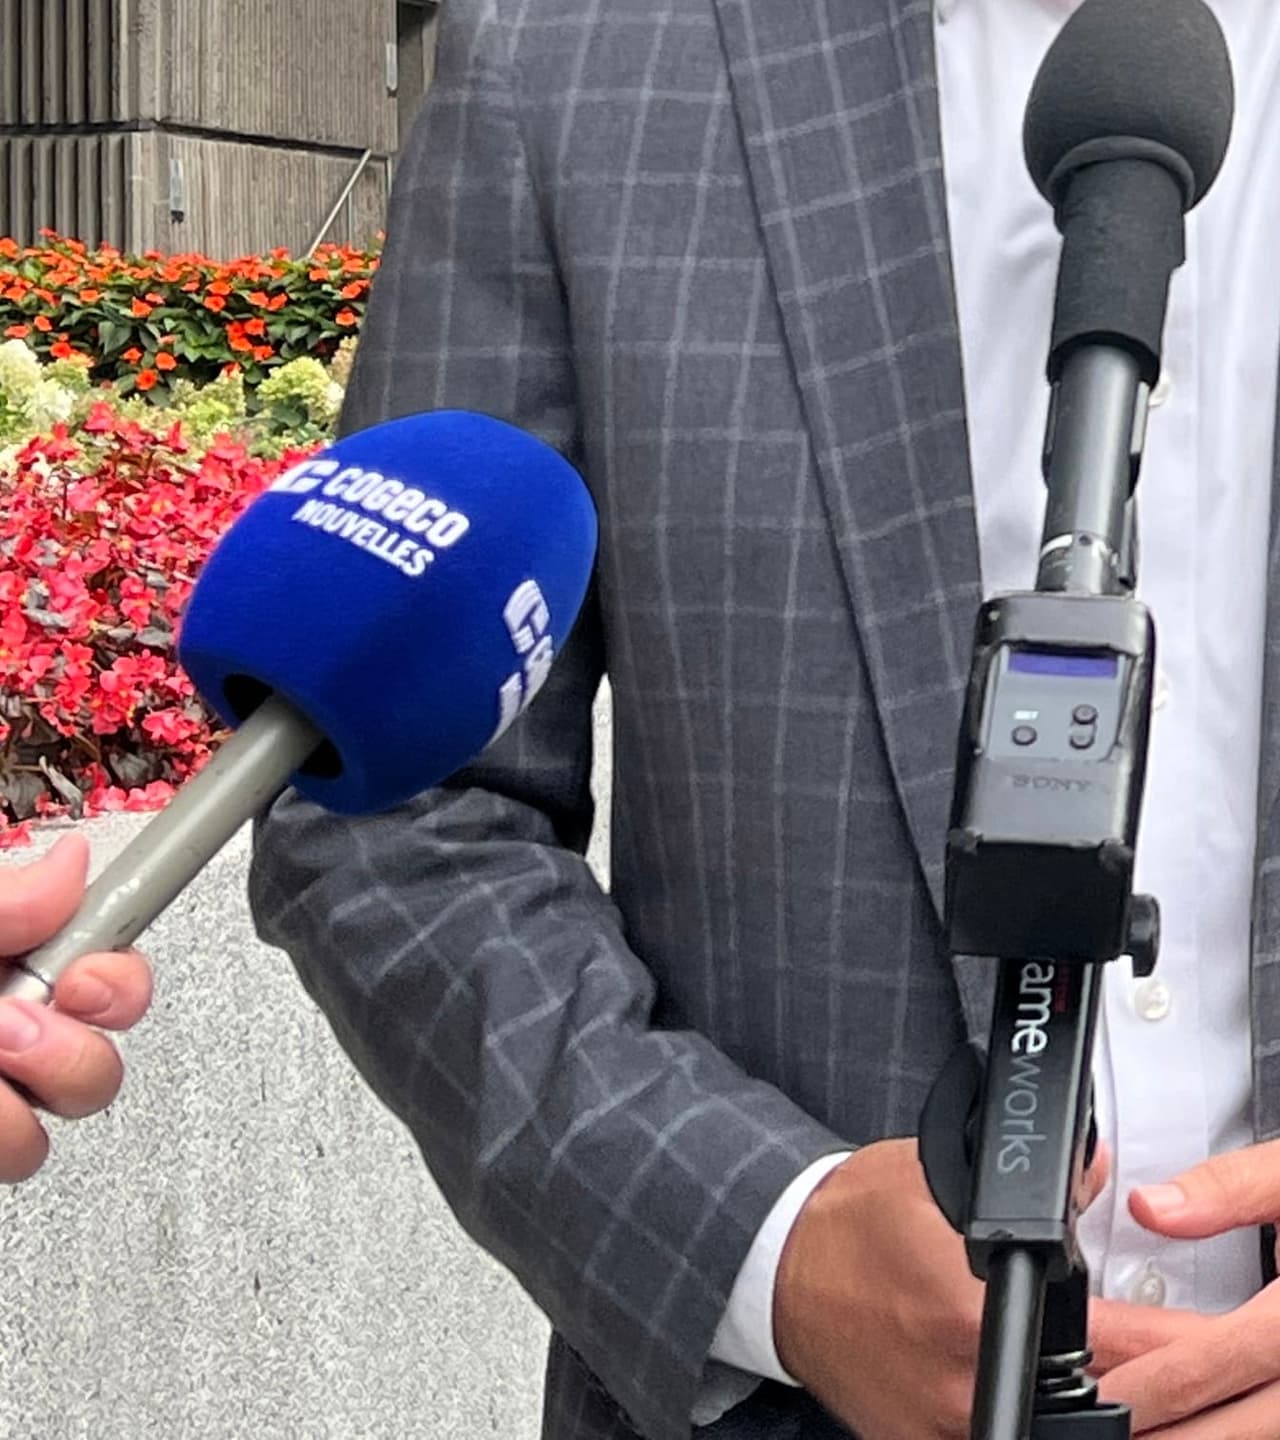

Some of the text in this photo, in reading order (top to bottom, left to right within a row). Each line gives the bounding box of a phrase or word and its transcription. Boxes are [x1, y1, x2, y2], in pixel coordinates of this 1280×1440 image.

[291, 499, 435, 577] NOUVELLES
[1012, 773, 1091, 792] SONY
[997, 960, 1055, 1175] ameworks
